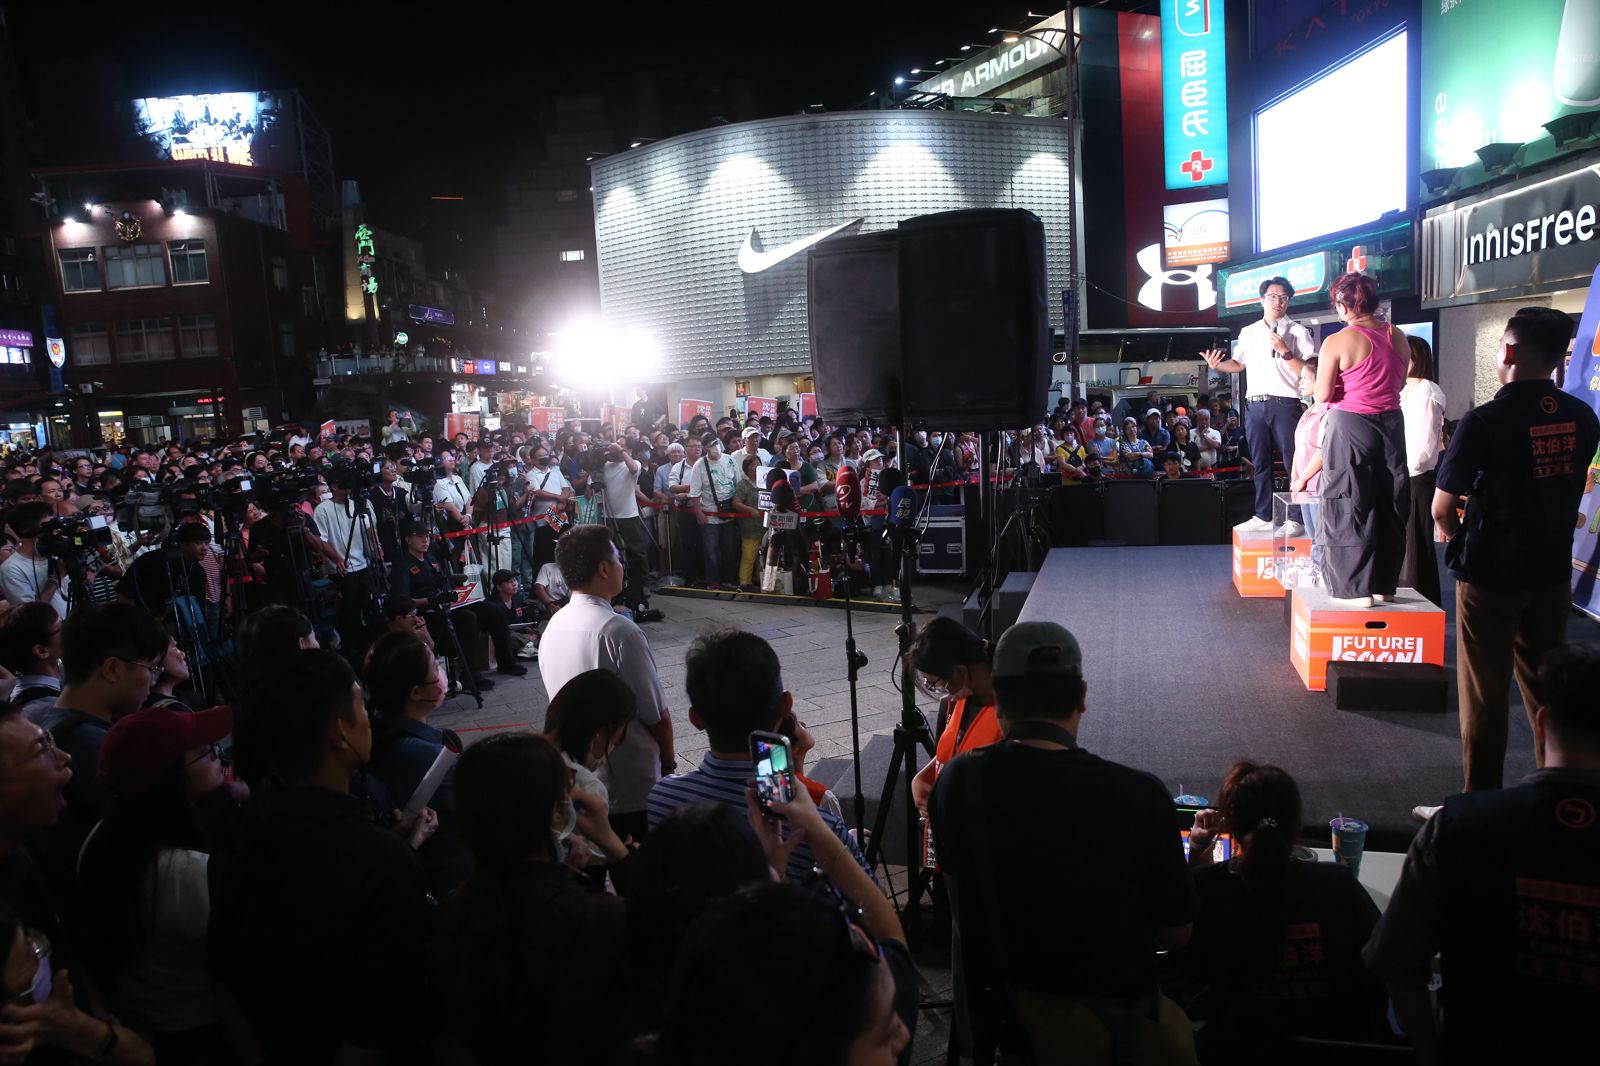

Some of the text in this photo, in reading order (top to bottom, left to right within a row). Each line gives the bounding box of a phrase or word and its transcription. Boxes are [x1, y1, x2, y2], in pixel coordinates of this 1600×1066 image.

[960, 28, 1061, 93] ARMOUR
[1180, 48, 1209, 137] 屈臣氏
[1531, 433, 1577, 456] 沈伯洋
[1343, 636, 1415, 651] FUTURE
